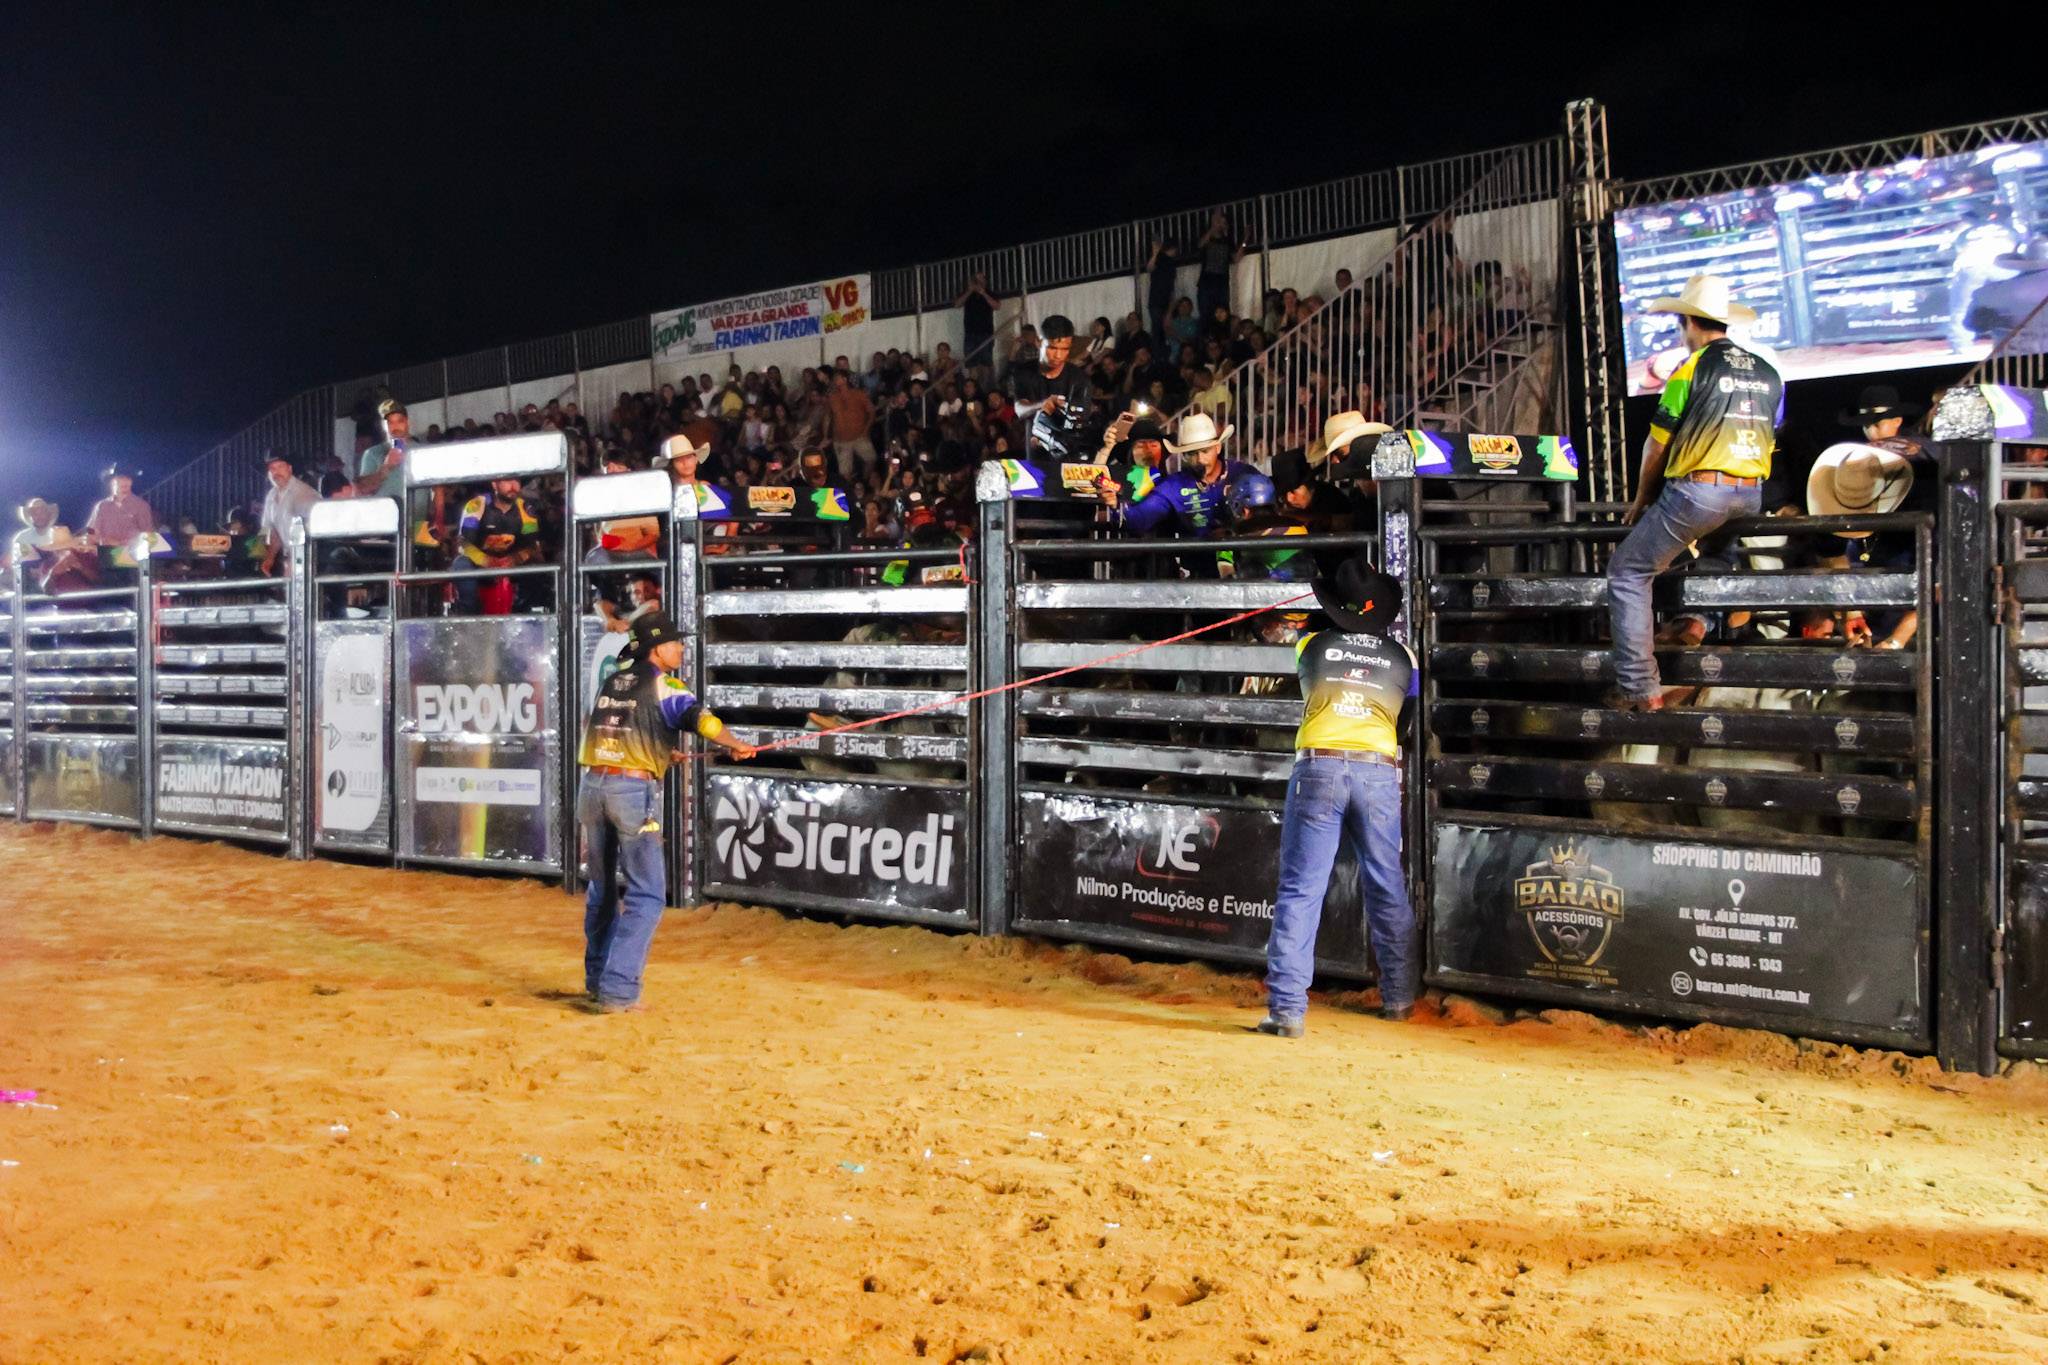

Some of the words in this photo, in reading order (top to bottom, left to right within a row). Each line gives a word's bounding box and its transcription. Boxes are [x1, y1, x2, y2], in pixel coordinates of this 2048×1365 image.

[824, 279, 858, 311] VG
[761, 302, 810, 323] GRANDE
[715, 324, 772, 349] FABINHO
[774, 315, 820, 340] TARDIN
[416, 683, 537, 733] EXPOVG
[848, 738, 886, 757] Sicredi
[917, 740, 957, 757] Sicredi
[160, 763, 221, 794] FABINHO
[223, 765, 283, 798] TARDIN
[775, 800, 955, 887] Sicredi
[1652, 845, 1718, 869] SHOPPING
[1722, 850, 1740, 870] DO
[1744, 852, 1821, 876] CAMINHÃO
[1077, 876, 1118, 898] Nilmo
[1122, 882, 1204, 912] Produções
[1208, 898, 1219, 913] e
[1222, 895, 1275, 919] Evento
[1520, 878, 1619, 915] BARÃO
[1535, 911, 1604, 928] ACESSÓRIOS
[1696, 923, 1727, 939] VÁRZEA
[1768, 931, 1782, 944] MT
[1739, 912, 1775, 927] CAMPOS
